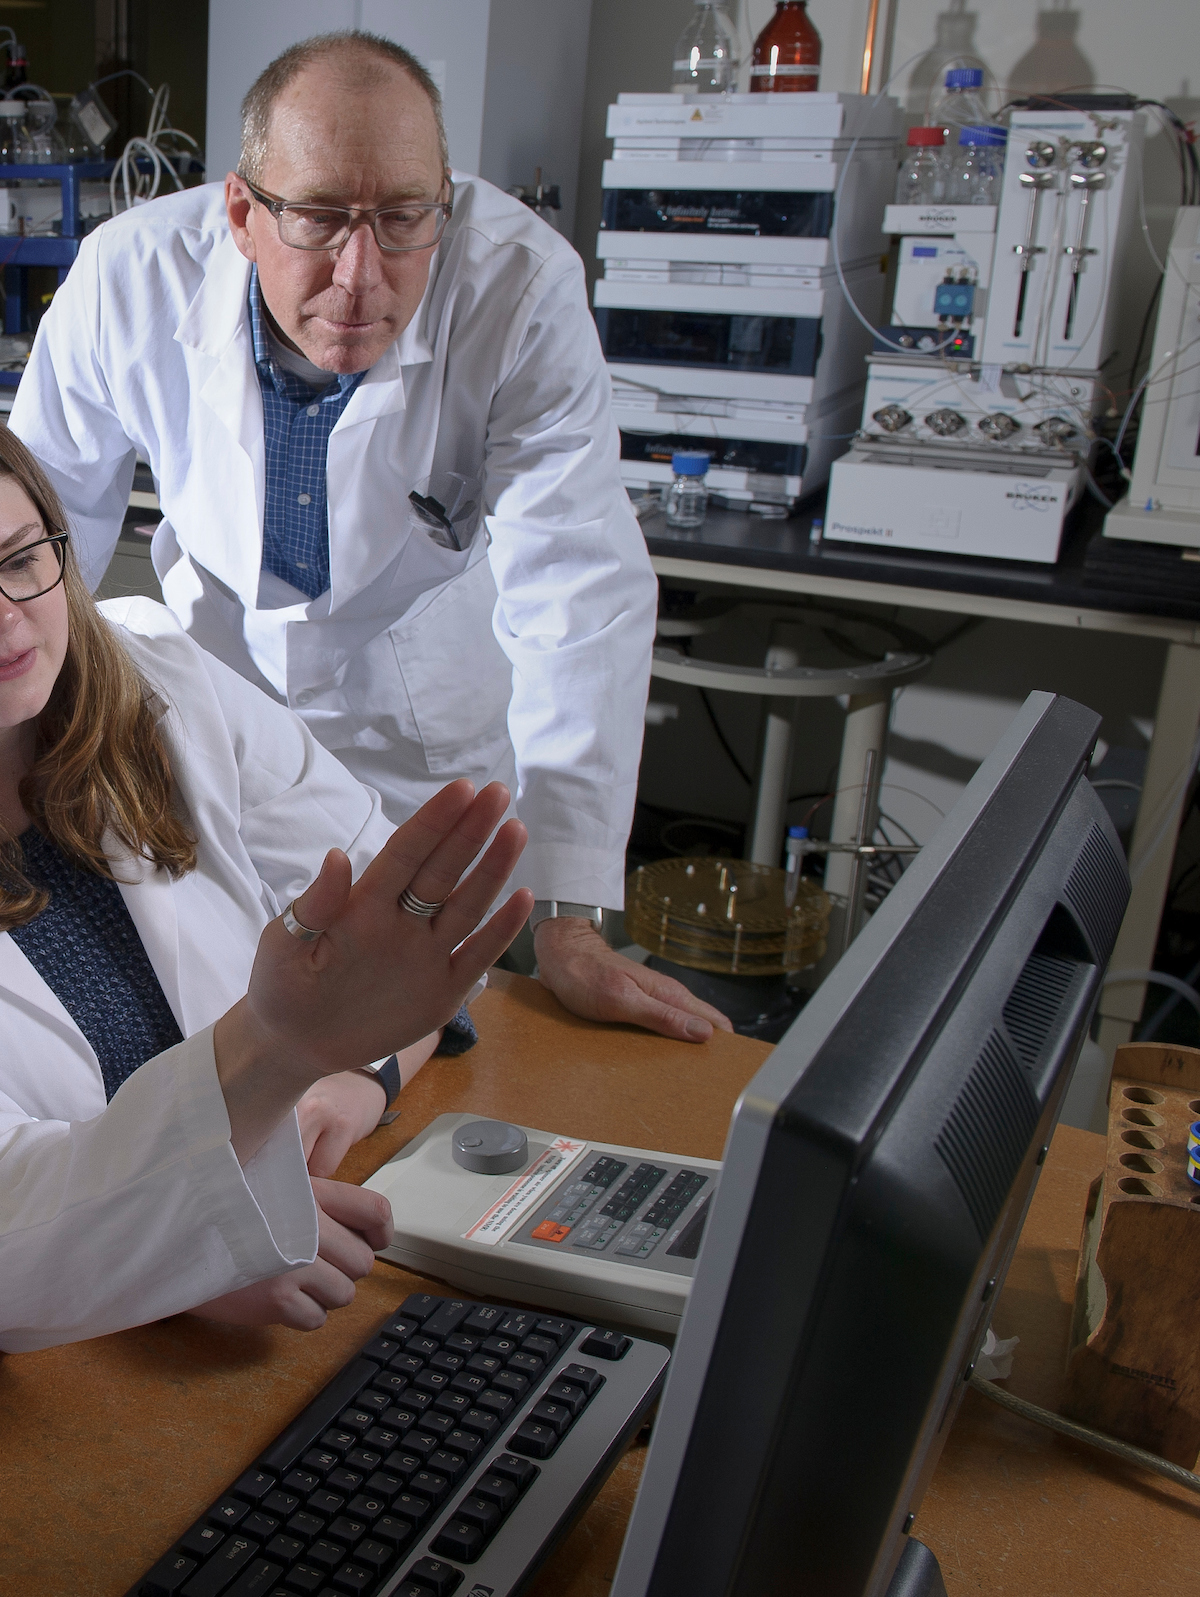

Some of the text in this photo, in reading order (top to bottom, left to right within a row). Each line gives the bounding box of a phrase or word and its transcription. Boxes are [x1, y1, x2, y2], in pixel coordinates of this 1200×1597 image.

[1005, 492, 1059, 503] BRUKER
[832, 522, 883, 538] Prospekt
[603, 1331, 613, 1340] Esc
